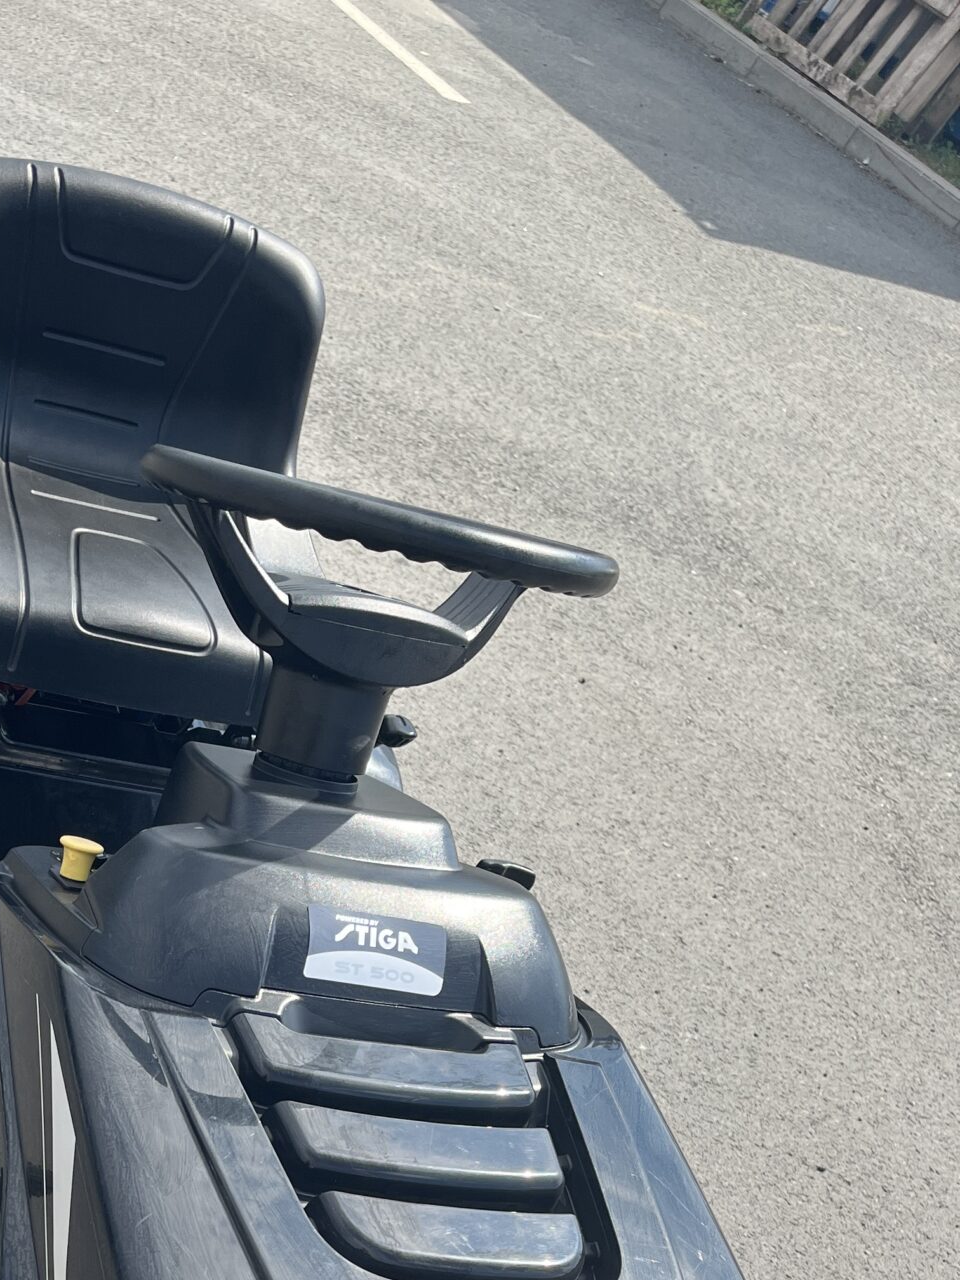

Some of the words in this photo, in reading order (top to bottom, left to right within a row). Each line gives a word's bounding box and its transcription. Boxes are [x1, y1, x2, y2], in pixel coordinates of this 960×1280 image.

[334, 923, 419, 955] STIGA
[334, 961, 364, 976] ST
[369, 966, 415, 984] 500
